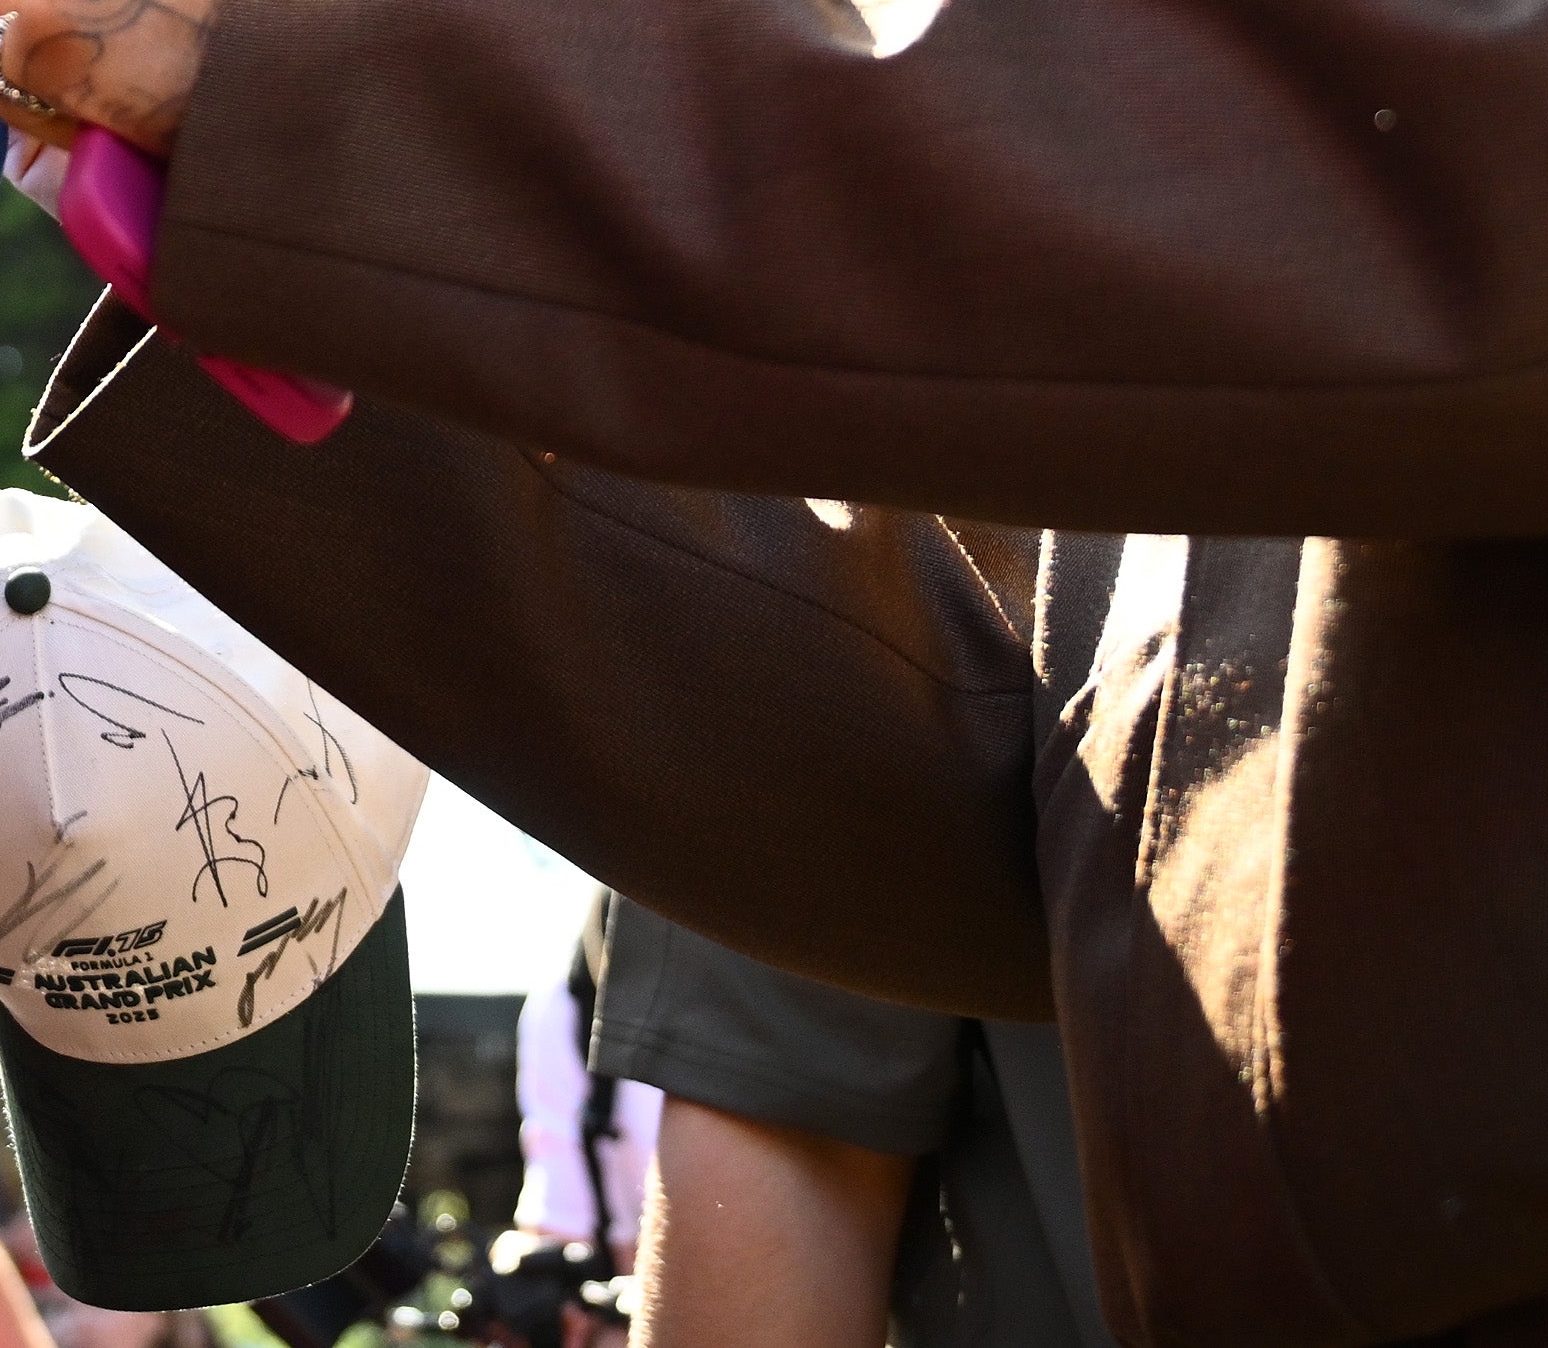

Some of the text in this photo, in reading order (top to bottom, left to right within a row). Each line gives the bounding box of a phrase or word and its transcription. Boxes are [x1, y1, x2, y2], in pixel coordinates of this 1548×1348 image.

[34, 945, 218, 992] AUSTRALIAN
[70, 954, 142, 972] FORMULA
[44, 969, 216, 1010] GRAND PRIX
[106, 1008, 160, 1025] 2025
